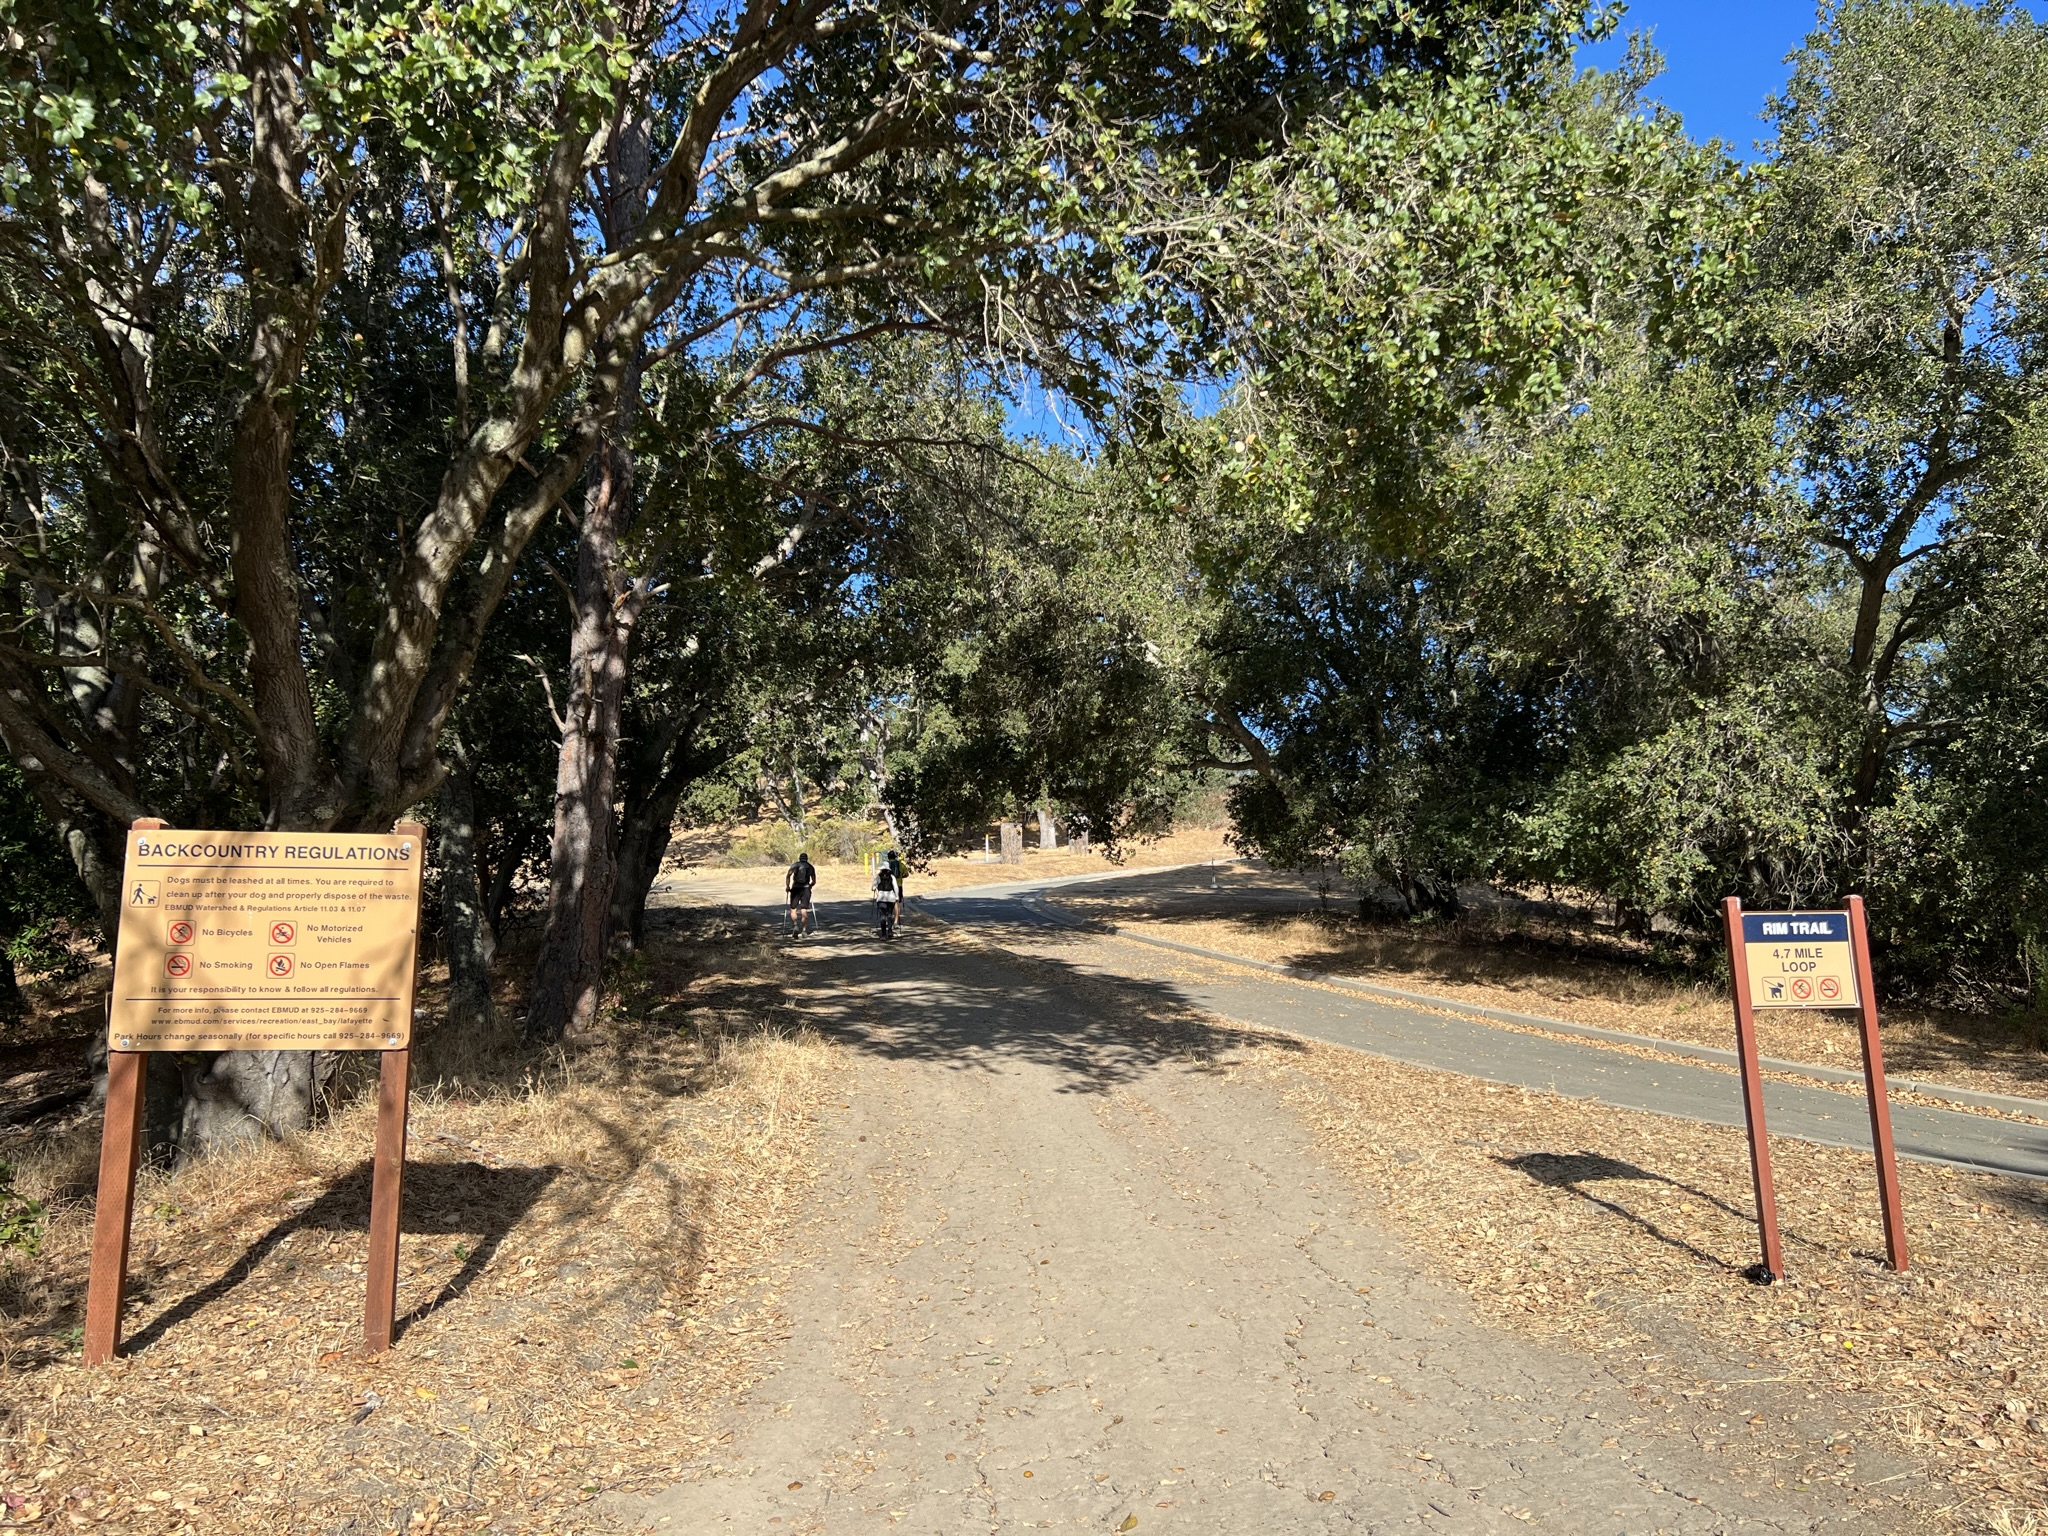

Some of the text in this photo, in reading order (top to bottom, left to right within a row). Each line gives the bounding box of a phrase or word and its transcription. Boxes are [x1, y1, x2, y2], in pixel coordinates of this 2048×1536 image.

[138, 844, 410, 861] BACKCOUNTRY REGULATIONS
[167, 877, 191, 885] Dogs
[348, 879, 383, 888] required
[166, 890, 188, 898] clean
[250, 891, 266, 900] dog
[286, 892, 321, 901] properly
[324, 892, 356, 902] dispose
[248, 905, 292, 913] Regulations
[217, 929, 253, 937] Bicycles
[1762, 921, 1834, 935] RIM TRAIL
[1773, 948, 1823, 958] 4.7 MILE
[215, 961, 253, 970] Smoking
[314, 962, 337, 970] Open
[1782, 962, 1816, 972] LOOP
[189, 986, 246, 995] responsibility
[331, 986, 378, 994] regulations.
[164, 1034, 196, 1042] change
[198, 1033, 243, 1041] seasonally
[245, 1033, 260, 1041] (for
[263, 1033, 295, 1041] specific
[323, 1032, 337, 1040] call
